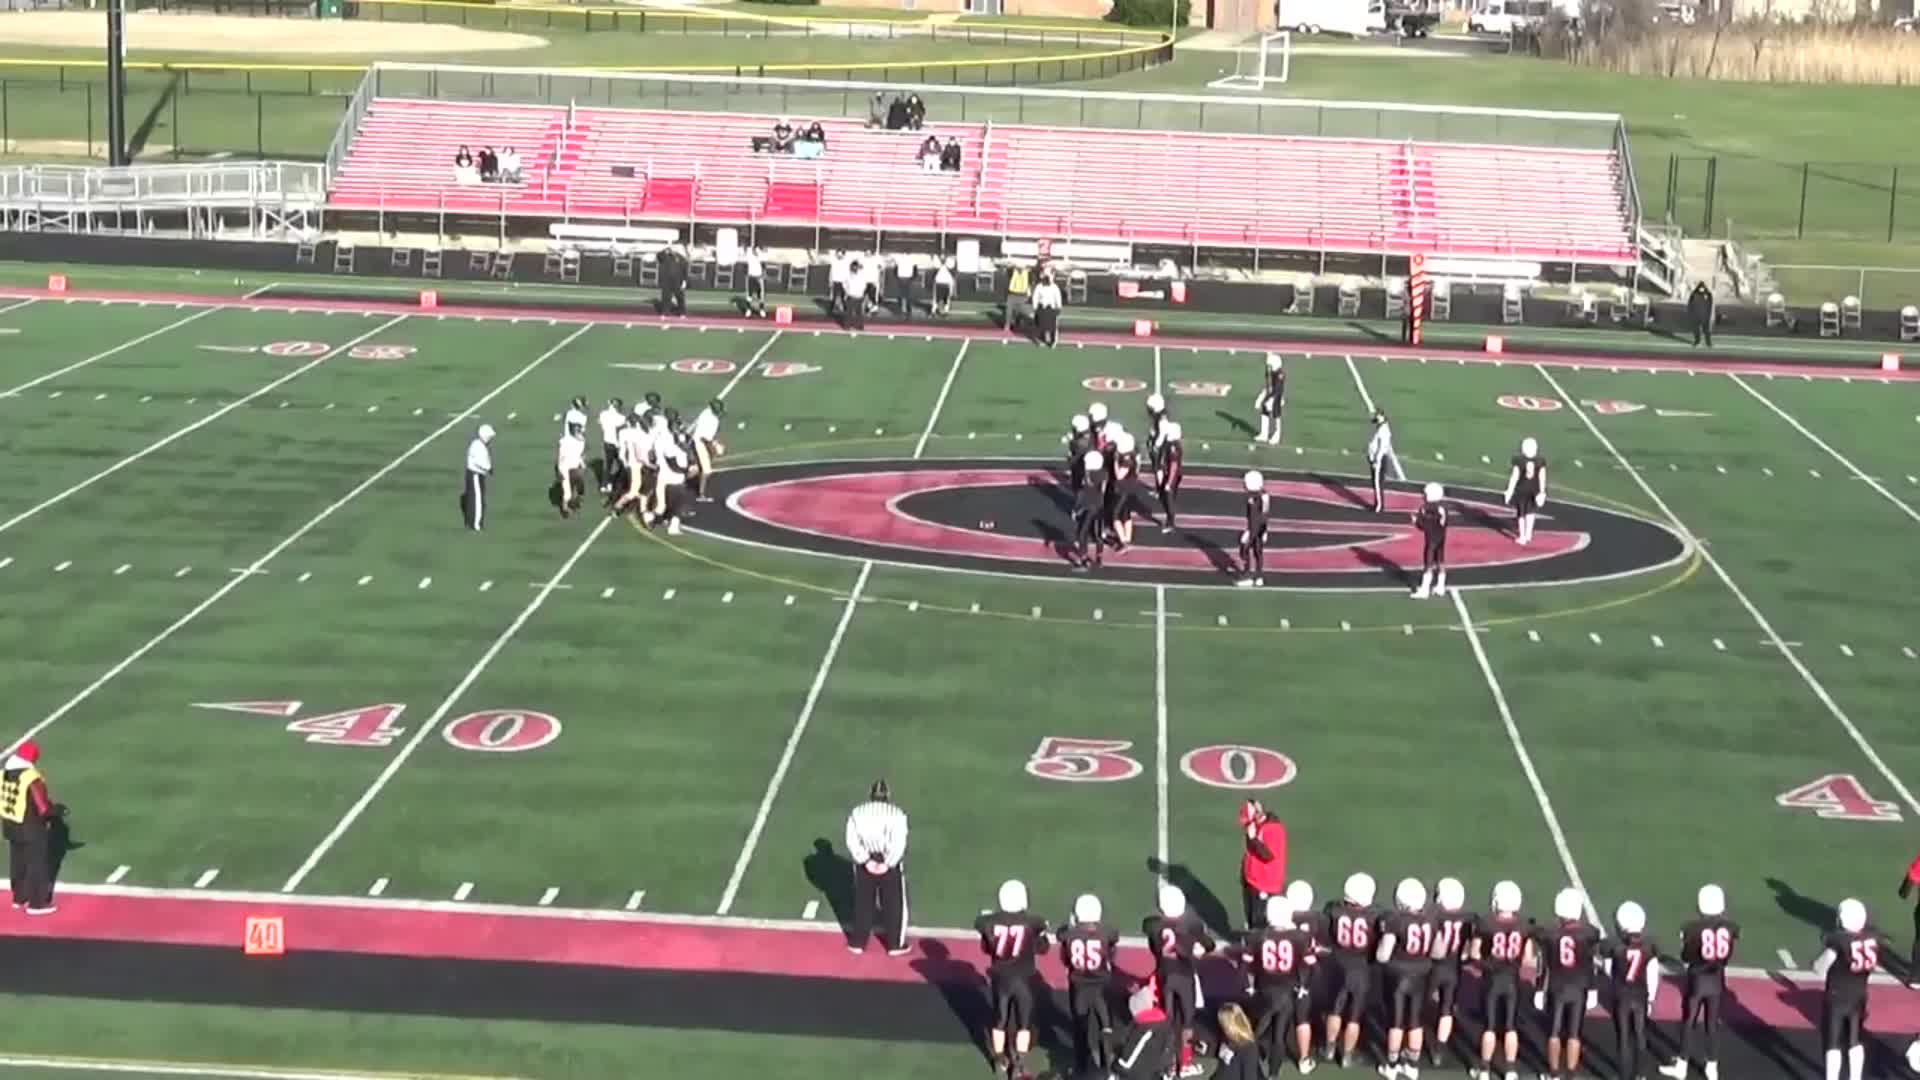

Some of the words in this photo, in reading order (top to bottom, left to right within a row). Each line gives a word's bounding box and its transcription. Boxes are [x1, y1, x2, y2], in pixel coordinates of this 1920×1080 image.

[249, 922, 279, 949] 40
[993, 924, 1025, 957] 77
[1161, 927, 1178, 959] 2
[1337, 914, 1369, 948] 66
[1406, 922, 1432, 955] 61
[1491, 931, 1523, 960] 88
[1700, 927, 1730, 960] 86
[1070, 938, 1102, 971] 85
[1261, 939, 1294, 972] 69
[1558, 935, 1576, 967] 6
[1625, 948, 1642, 982] 7
[1850, 938, 1878, 971] 55
